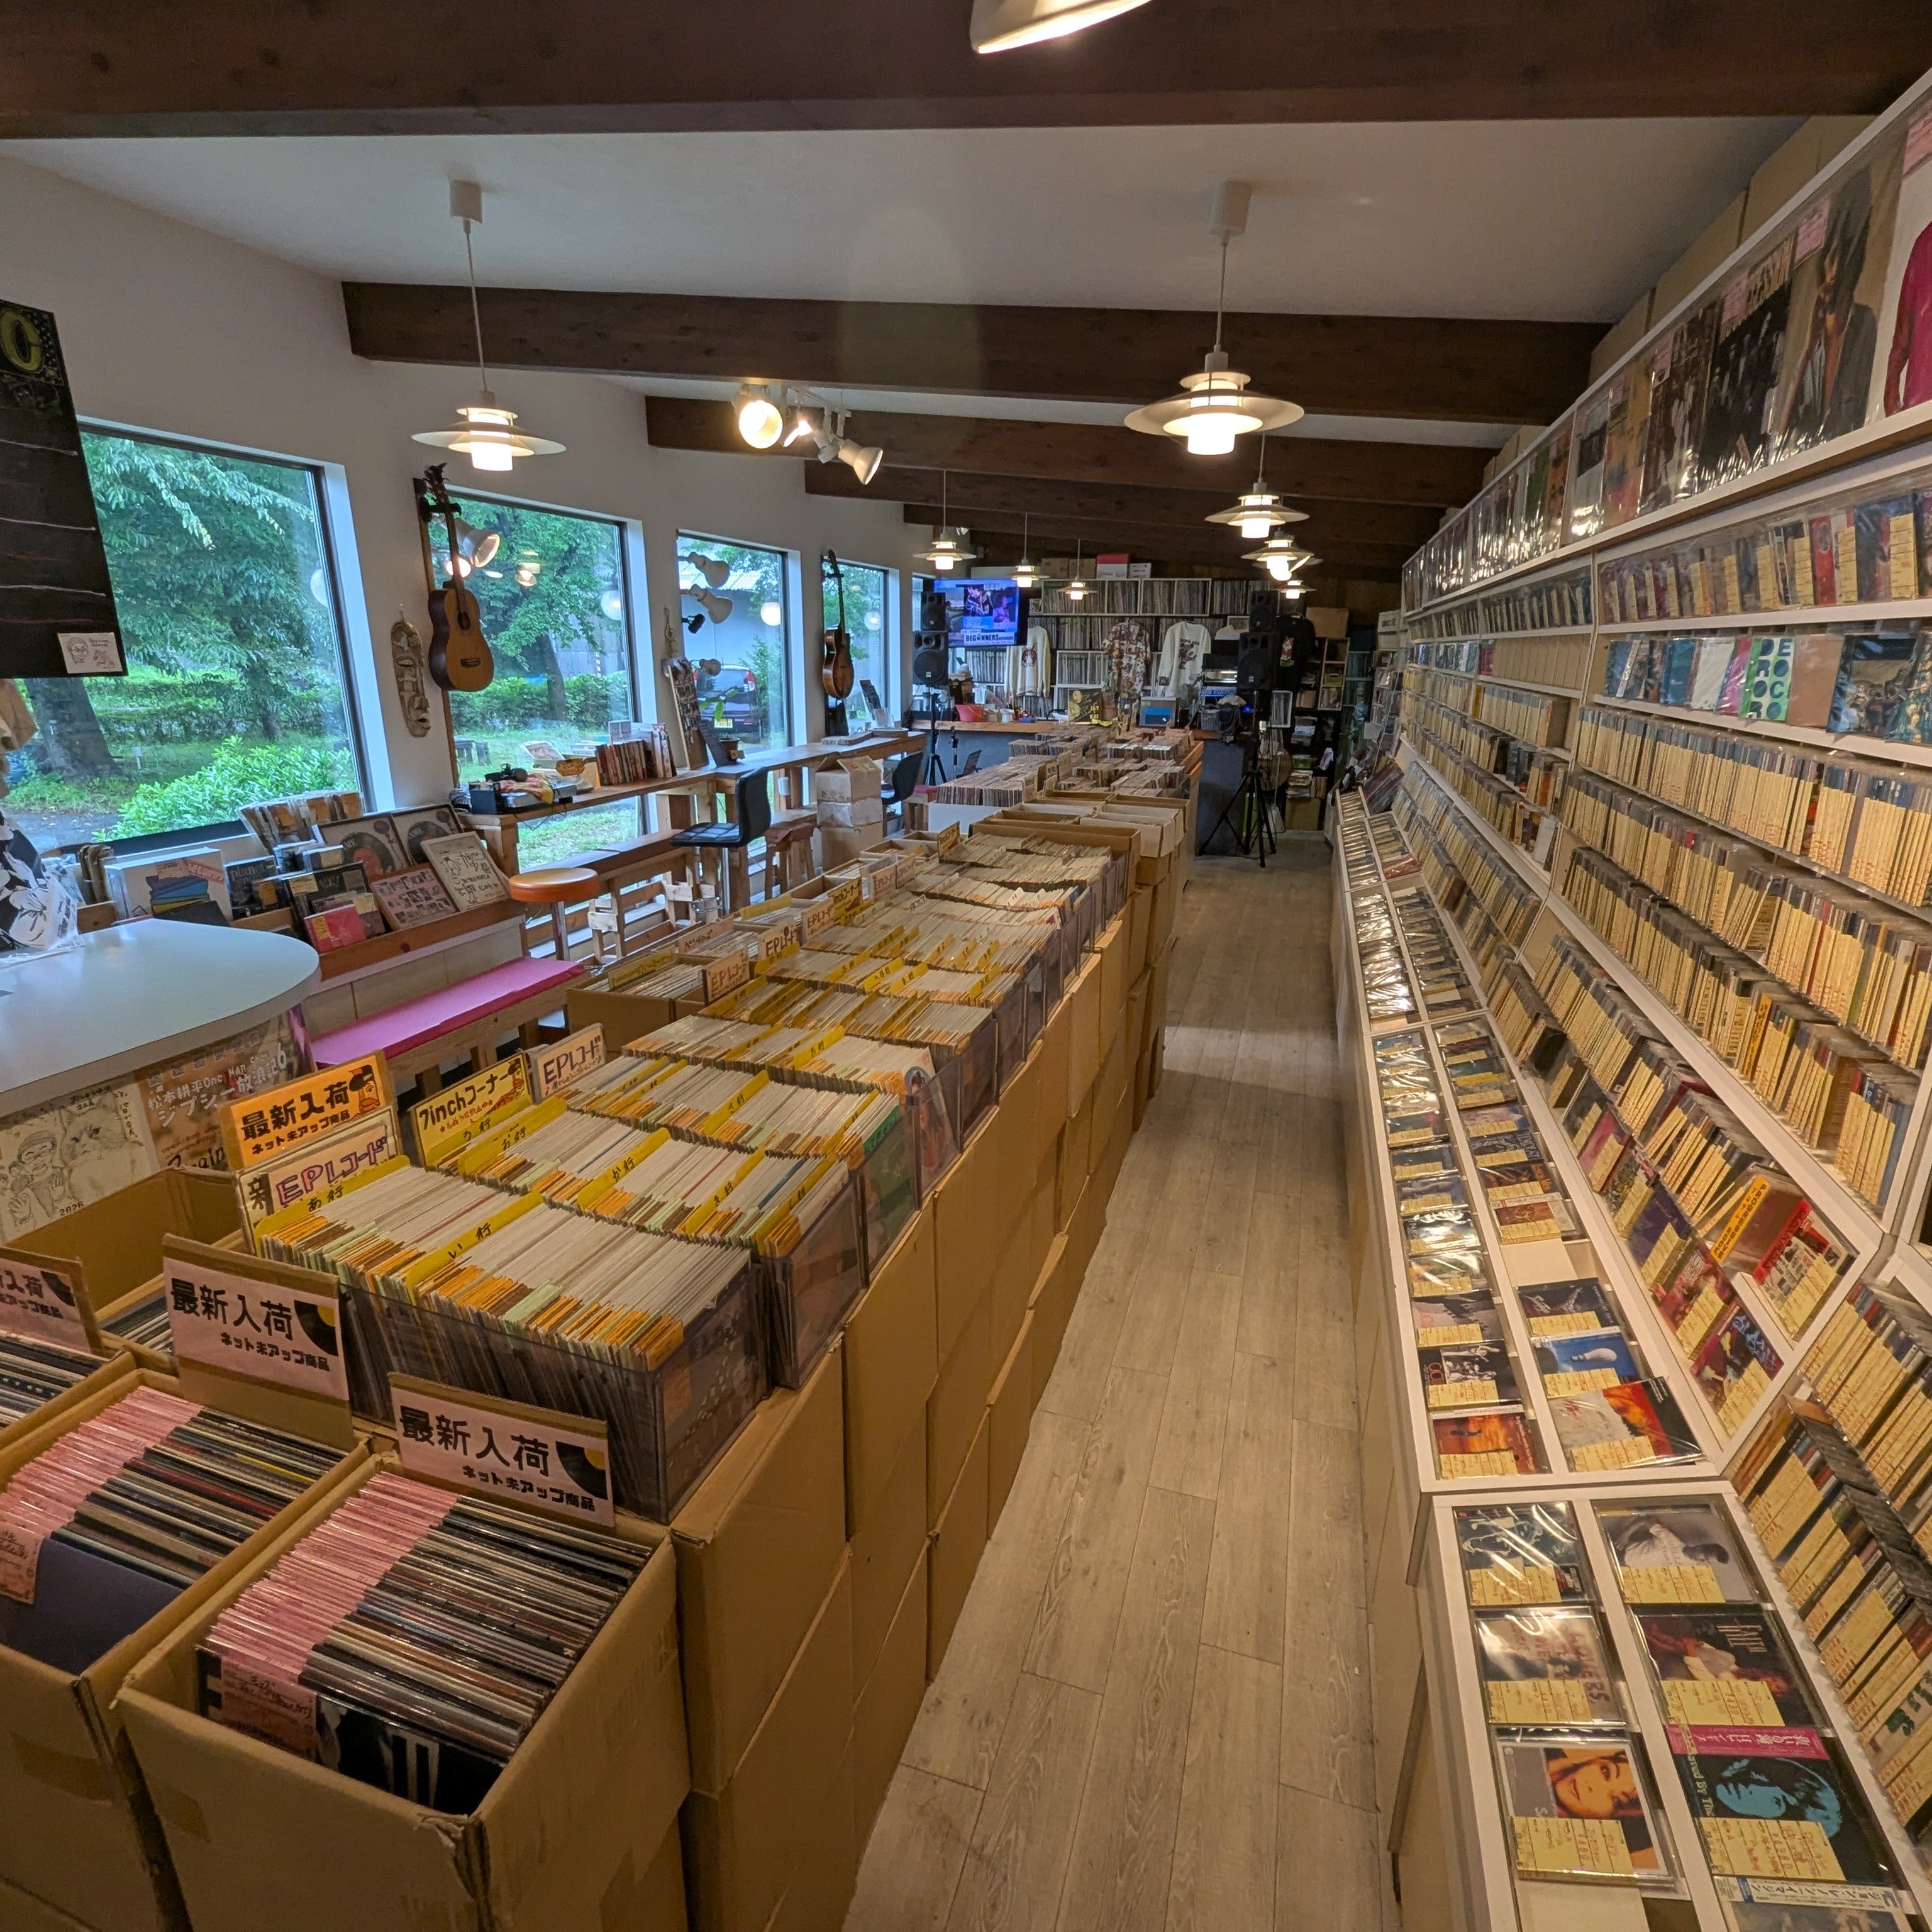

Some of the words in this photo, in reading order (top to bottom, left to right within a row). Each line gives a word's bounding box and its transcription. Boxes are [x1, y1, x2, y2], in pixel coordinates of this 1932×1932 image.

[543, 1035, 601, 1085] EPレコード
[241, 1080, 350, 1141] 最新入荷
[419, 1070, 511, 1131] 7inchコーナー
[252, 1109, 351, 1155] ネット未アップ商品
[275, 1135, 387, 1208] EPレコード
[170, 1277, 293, 1342] 最新入荷
[220, 1331, 331, 1372] ネット未アップ商品
[399, 1404, 550, 1478] 最新入荷
[462, 1465, 596, 1513] ネット未アップ商品
